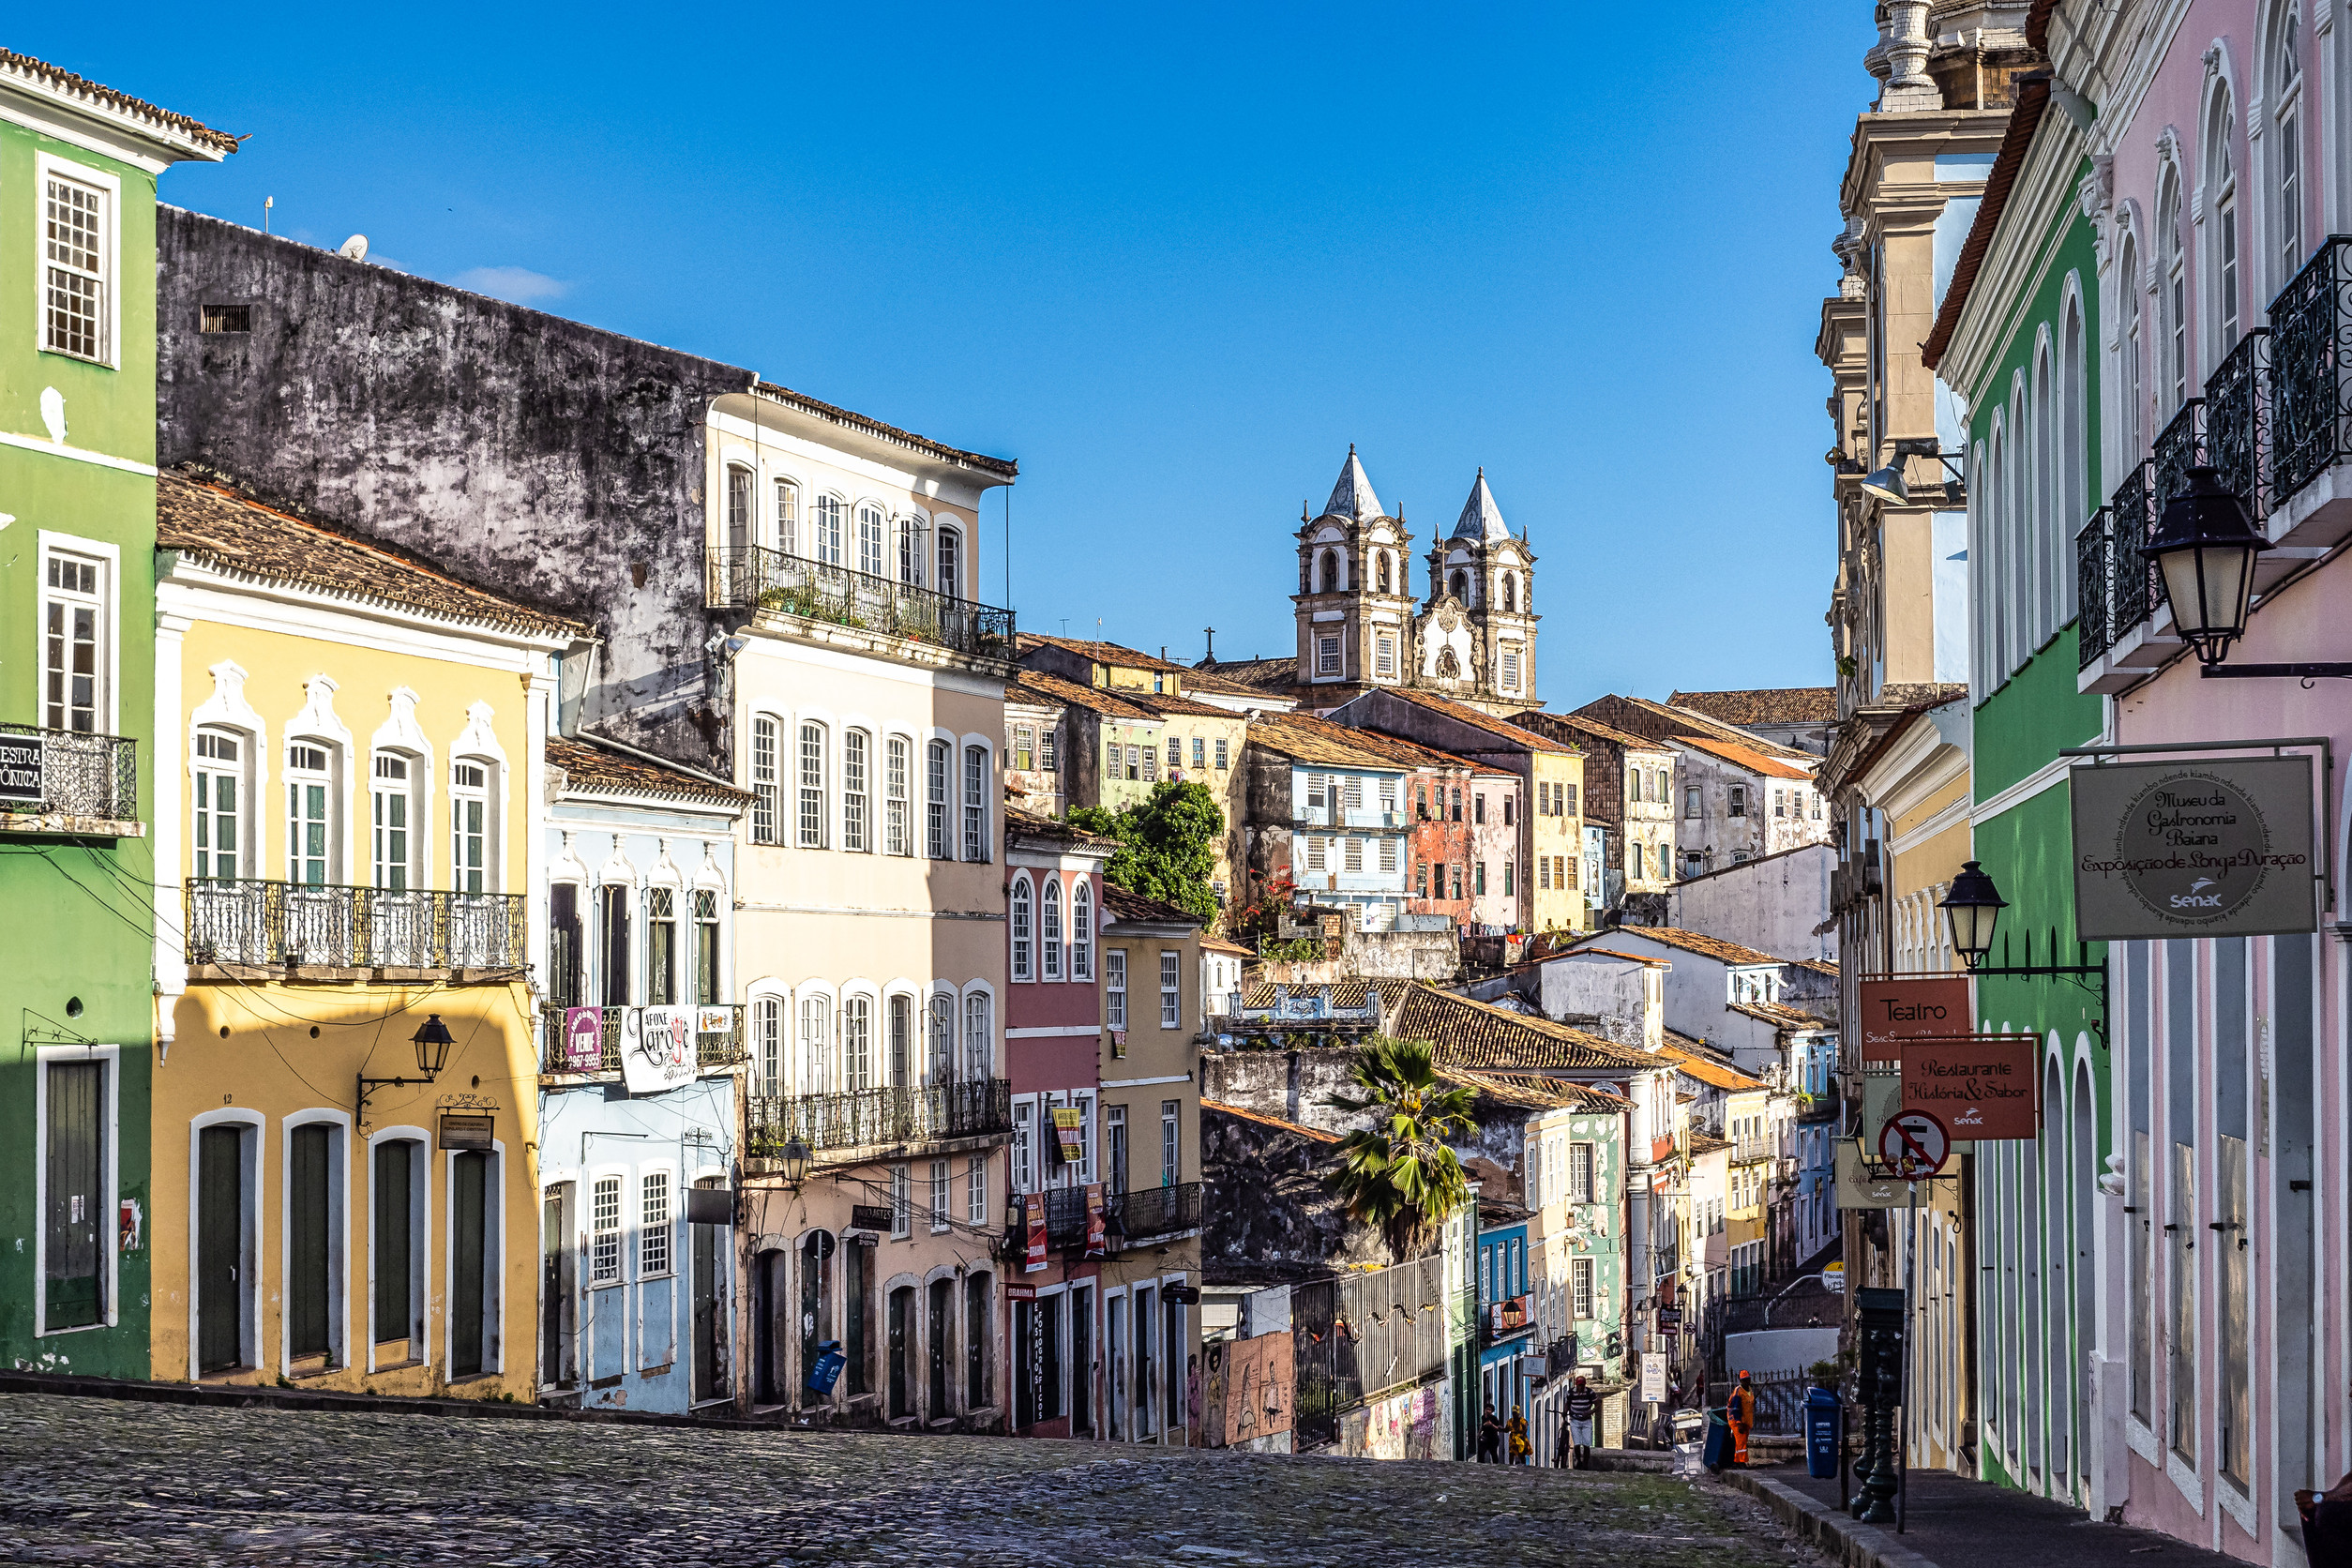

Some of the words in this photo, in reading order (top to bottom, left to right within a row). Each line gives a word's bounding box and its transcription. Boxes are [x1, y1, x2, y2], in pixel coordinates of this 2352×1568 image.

[0, 746, 42, 766] ESTRA
[0, 764, 42, 789] ÔNICA
[2159, 769, 2189, 786] ndende
[2190, 768, 2220, 783] kiambo
[2130, 780, 2160, 804] kiambo
[2155, 791, 2207, 808] Museu
[2209, 790, 2225, 807] da
[2220, 778, 2248, 799] ndende
[2117, 804, 2136, 830] ndende
[2245, 793, 2266, 824] kiambo
[2147, 809, 2237, 837] Gastronomia
[2114, 829, 2124, 861] kiambo
[2166, 829, 2219, 847] Baiana
[2260, 823, 2274, 853] ndende
[2081, 854, 2164, 879] Exposição
[2164, 851, 2186, 869] de
[2187, 851, 2237, 880] Longa
[2238, 848, 2306, 871] Duração
[2119, 870, 2140, 898] ndende
[2251, 867, 2272, 895] kiambo
[2138, 896, 2164, 922] kiambo
[2228, 895, 2254, 916] ndende
[2164, 914, 2195, 928] ndende
[2197, 912, 2228, 928] kiambo
[1879, 999, 1947, 1021] Teatro
[575, 1032, 596, 1053] VENDE
[1921, 1059, 2012, 1078] Restaurante
[223, 1093, 233, 1105] 12
[1908, 1081, 1963, 1100] História
[1964, 1078, 1983, 1101] &
[1983, 1080, 2028, 1099] Sabor
[1902, 1124, 1928, 1166] E
[1008, 1288, 1033, 1298] BRAHMA
